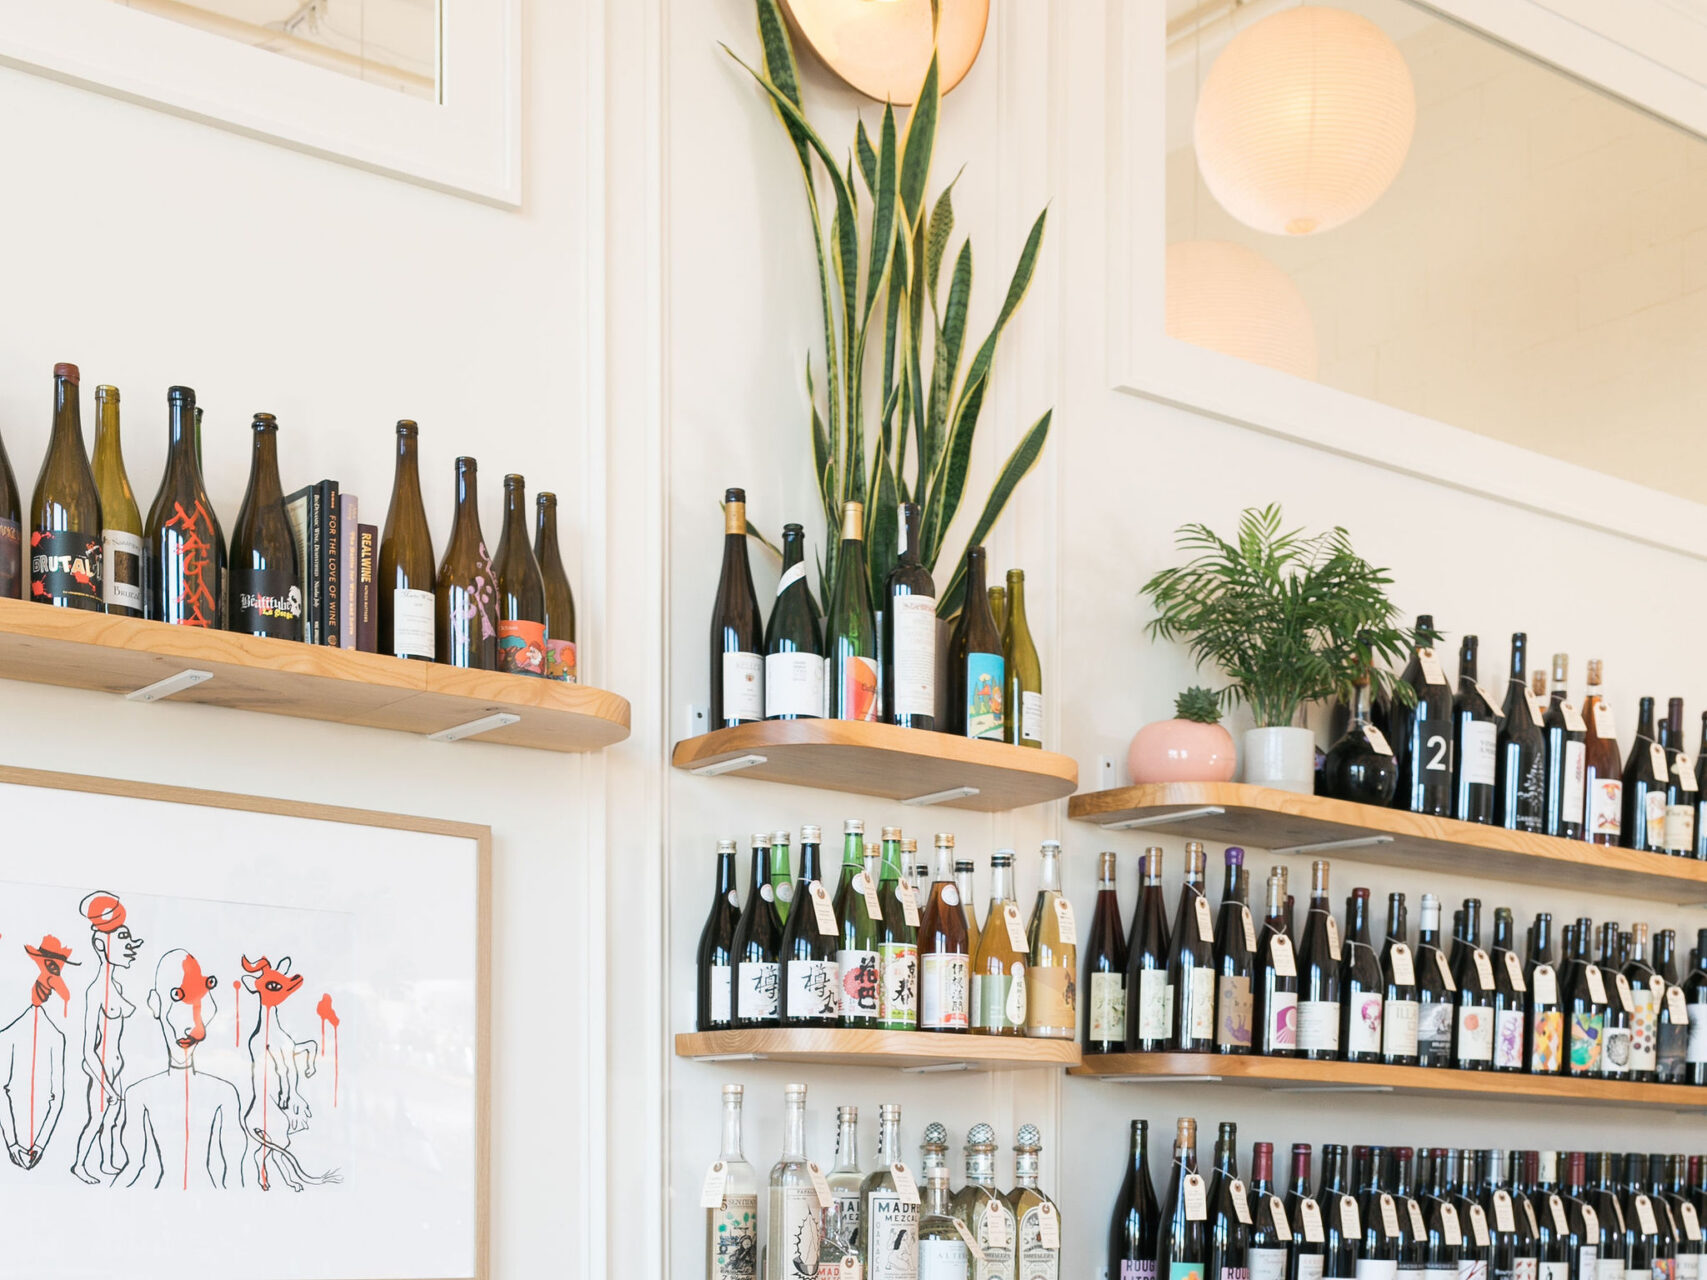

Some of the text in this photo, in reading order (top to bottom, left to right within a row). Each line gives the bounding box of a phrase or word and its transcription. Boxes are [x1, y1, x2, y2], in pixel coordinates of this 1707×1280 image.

[329, 515, 337, 535] FOR
[329, 538, 337, 555] THE
[361, 533, 372, 558] REAL
[329, 558, 337, 582] LOVE
[361, 558, 372, 583] WINE
[329, 585, 337, 599] OF
[329, 602, 337, 626] WINE
[1426, 735, 1447, 771] 2
